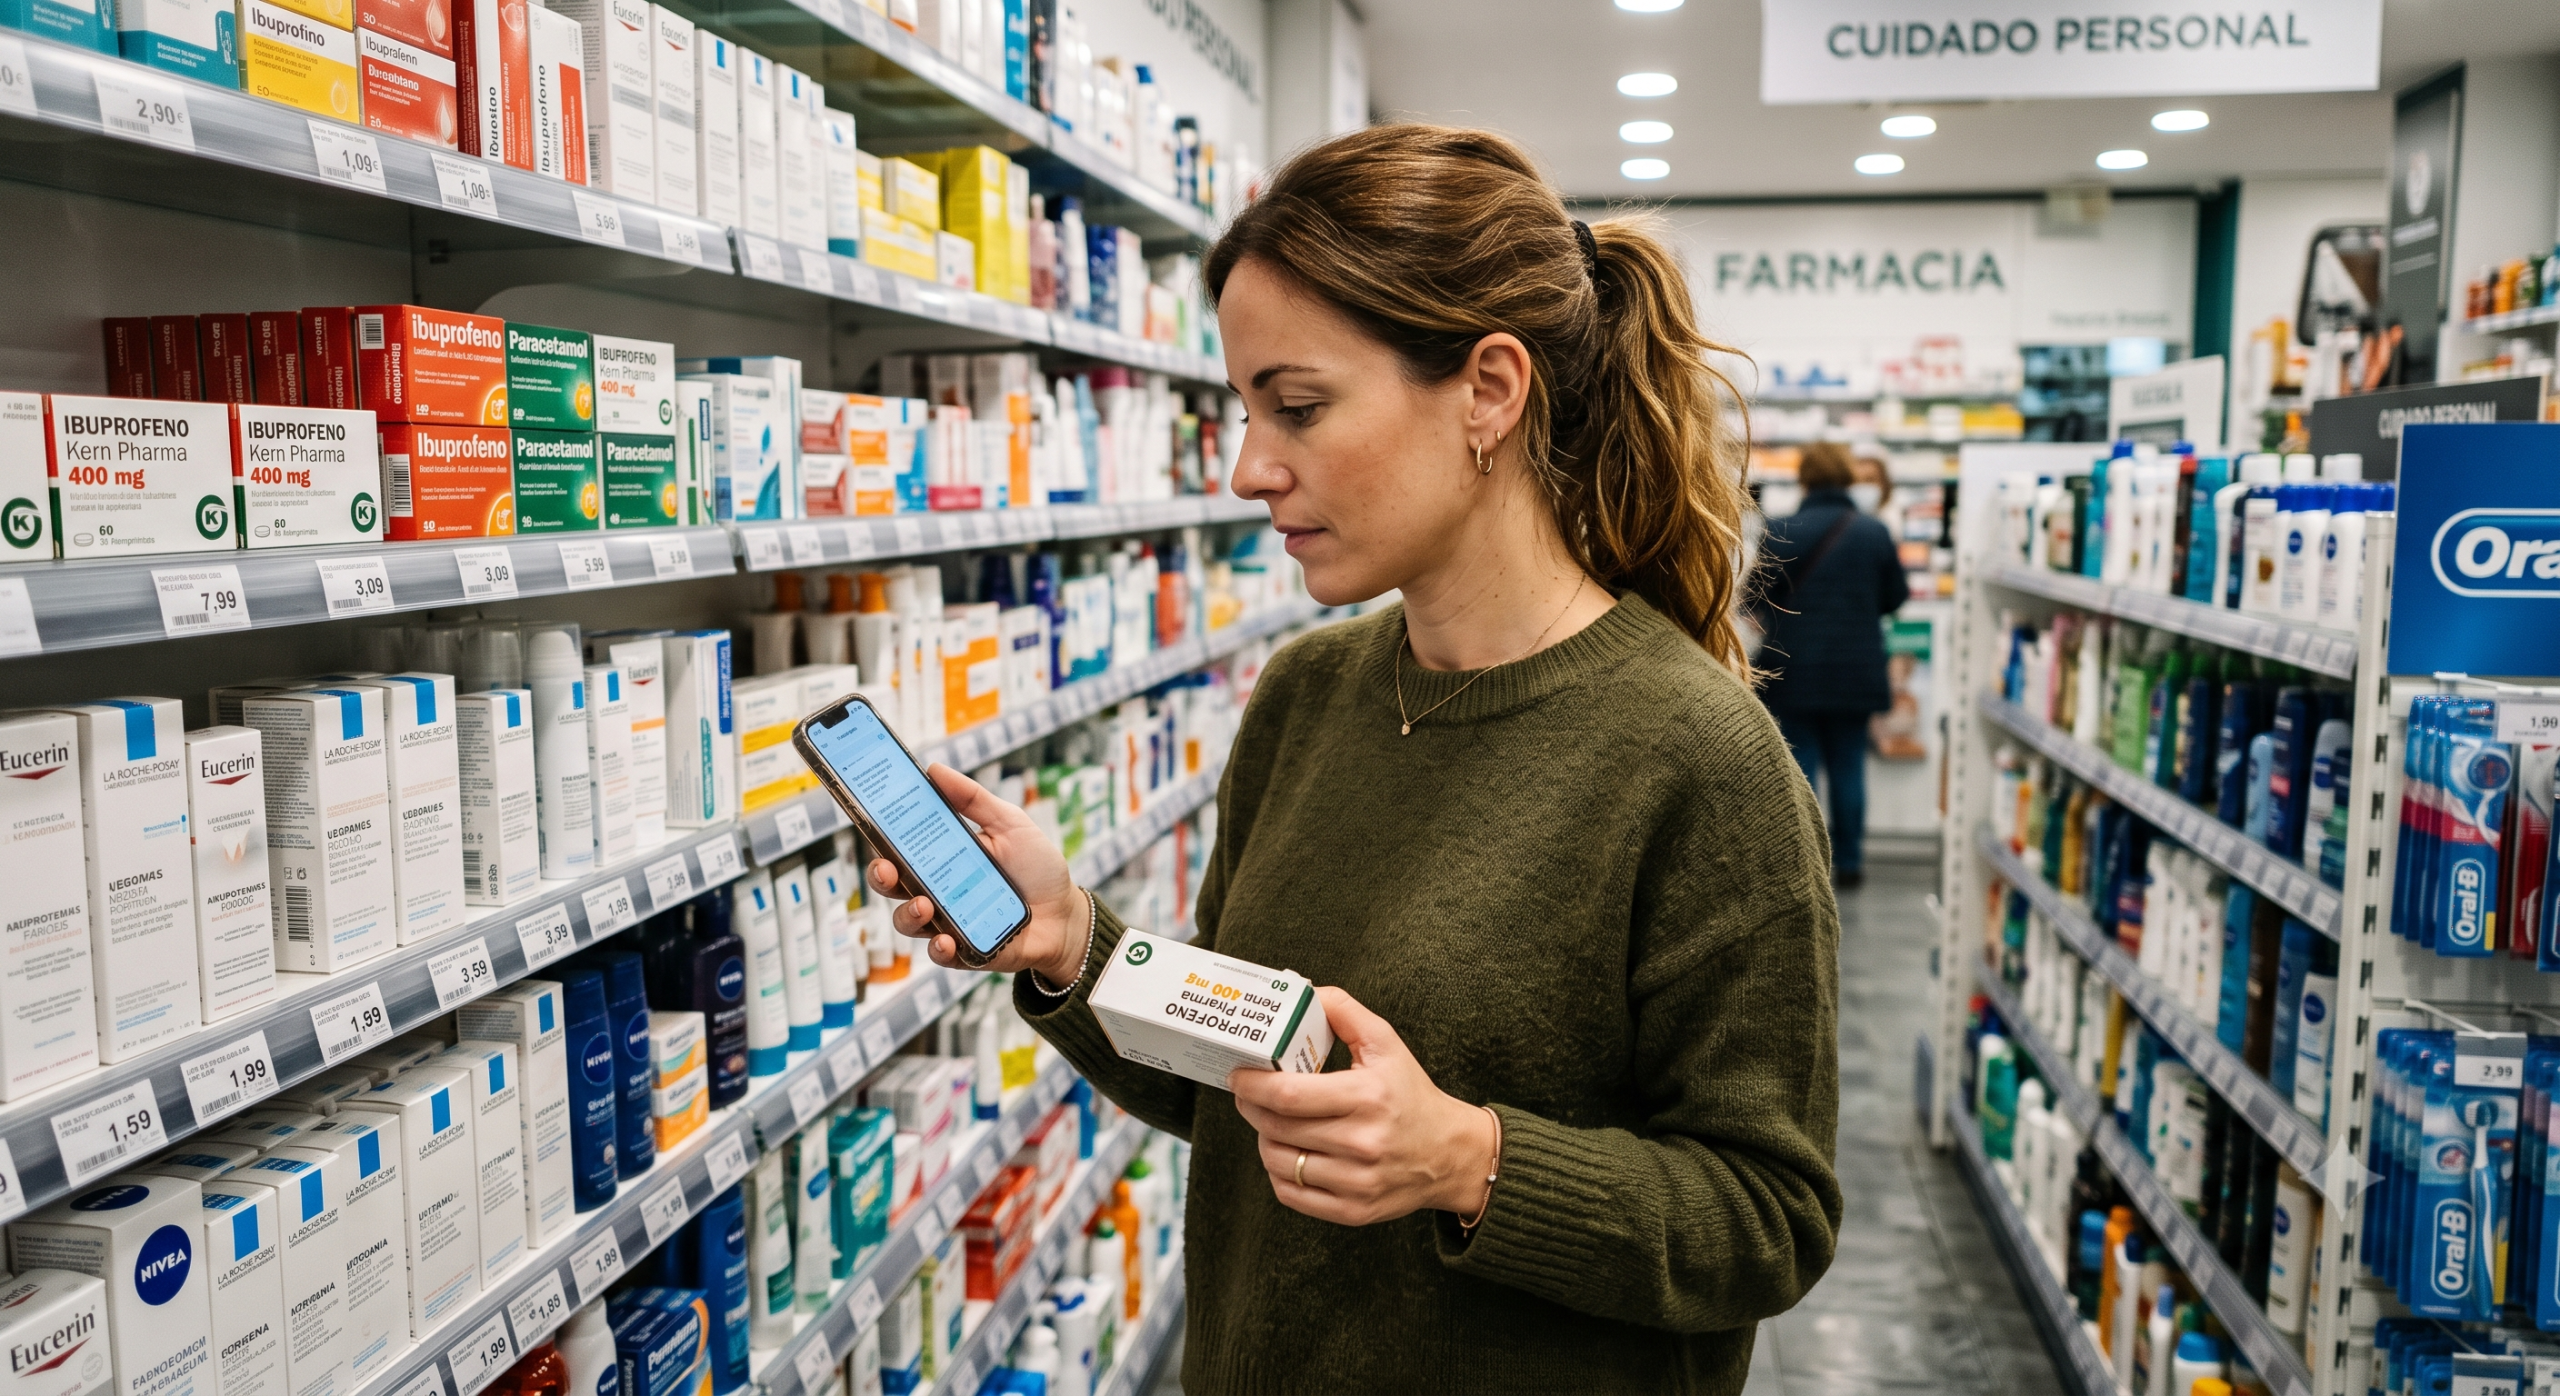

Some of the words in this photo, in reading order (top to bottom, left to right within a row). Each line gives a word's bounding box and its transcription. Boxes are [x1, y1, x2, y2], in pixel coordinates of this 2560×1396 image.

[1826, 18, 2040, 58] CUIDADO
[2054, 12, 2310, 54] PERSONAL
[1716, 250, 2006, 294] FARMACIA
[411, 314, 502, 349] ibuprofeno
[508, 329, 588, 358] Paracetamol
[599, 346, 657, 366] IBUPROFENO
[600, 363, 620, 379] Kern
[622, 366, 656, 382] Pharma
[601, 381, 619, 394] 400
[621, 383, 636, 397] mg
[64, 415, 189, 437] IBUPROFENO
[248, 421, 346, 441] IBUPROFENO
[66, 440, 111, 461] Kern
[118, 442, 188, 461] Pharma
[250, 444, 286, 462] Kern
[290, 444, 346, 462] Pharma
[417, 432, 507, 462] Ibuprofeno
[517, 437, 593, 459] Paracetamol
[607, 441, 674, 462] Paracetamol
[68, 466, 108, 486] 400
[114, 470, 146, 489] mg
[250, 466, 283, 484] 400
[287, 469, 311, 488] mg
[205, 511, 218, 526] K
[358, 504, 370, 519] K
[13, 514, 30, 532] K
[99, 524, 114, 536] 60
[275, 519, 286, 529] 60
[484, 565, 509, 585] 3,09
[355, 577, 384, 600] 3,09
[201, 590, 237, 613] 7,99
[0, 743, 69, 772] Eucerin
[201, 753, 255, 778] Eucerin
[103, 771, 116, 783] LA
[118, 758, 180, 780] ROCHE-POSAY
[2456, 867, 2478, 939] Oral-B
[461, 960, 487, 984] 3,59
[1184, 972, 1210, 989] mg
[1212, 983, 1242, 1001] 400
[1271, 979, 1289, 992] 60
[1165, 1002, 1267, 1043] IBUPROFENO
[1241, 1009, 1275, 1028] Kern
[230, 1059, 266, 1088] 1,99
[108, 1109, 151, 1142] 1,59
[2439, 1209, 2466, 1290] Oral-B
[141, 1248, 187, 1282] NIVEA
[10, 1309, 95, 1374] Eucerin
[480, 1336, 506, 1367] 1,99
